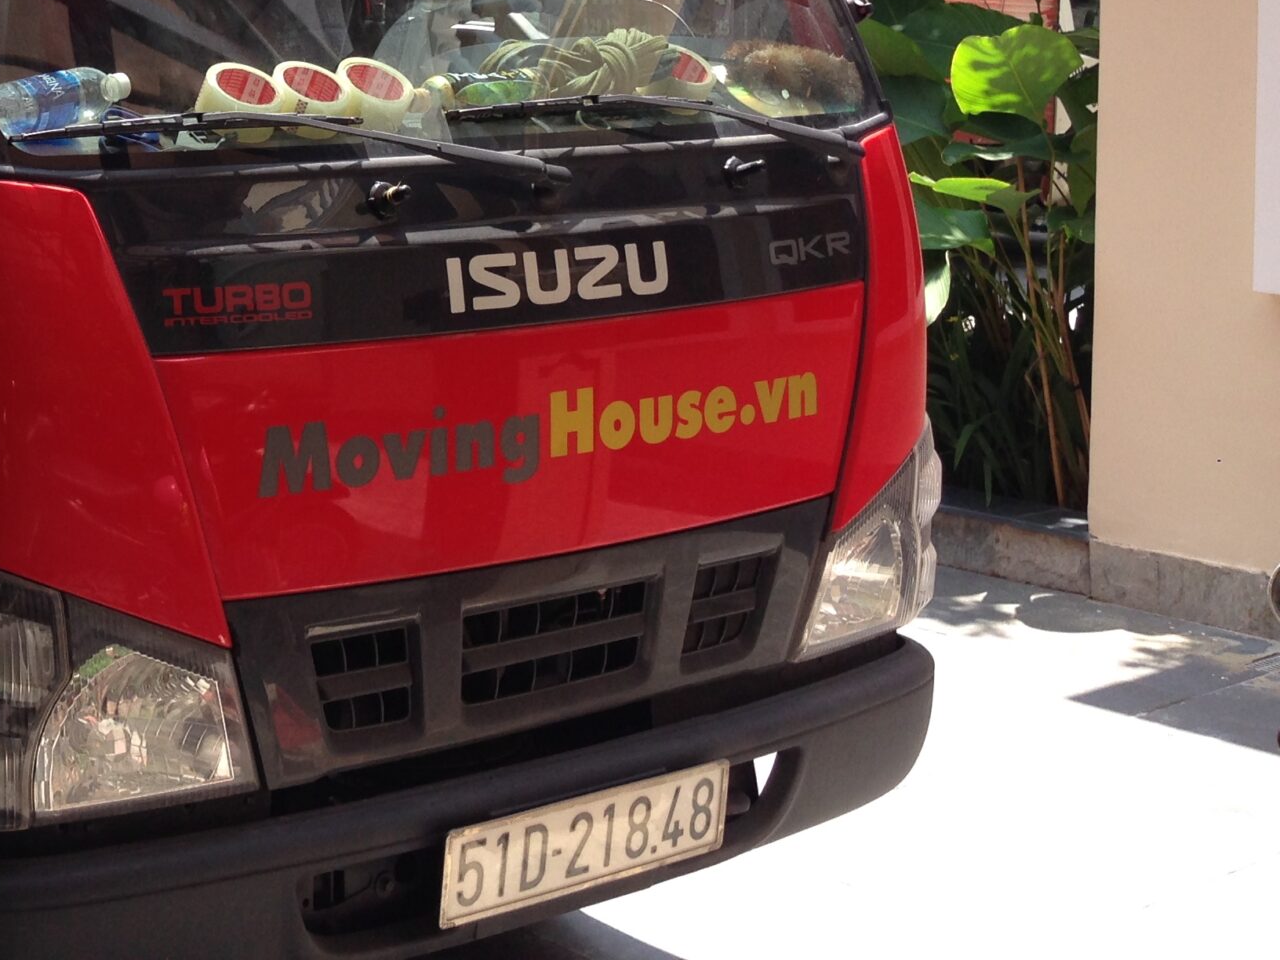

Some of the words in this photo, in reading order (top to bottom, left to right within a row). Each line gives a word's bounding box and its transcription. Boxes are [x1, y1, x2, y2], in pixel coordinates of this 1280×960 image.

[767, 230, 852, 267] QKR
[161, 280, 313, 316] TURBO
[446, 239, 670, 315] ISUZU
[456, 776, 715, 908] 51D-218.48
